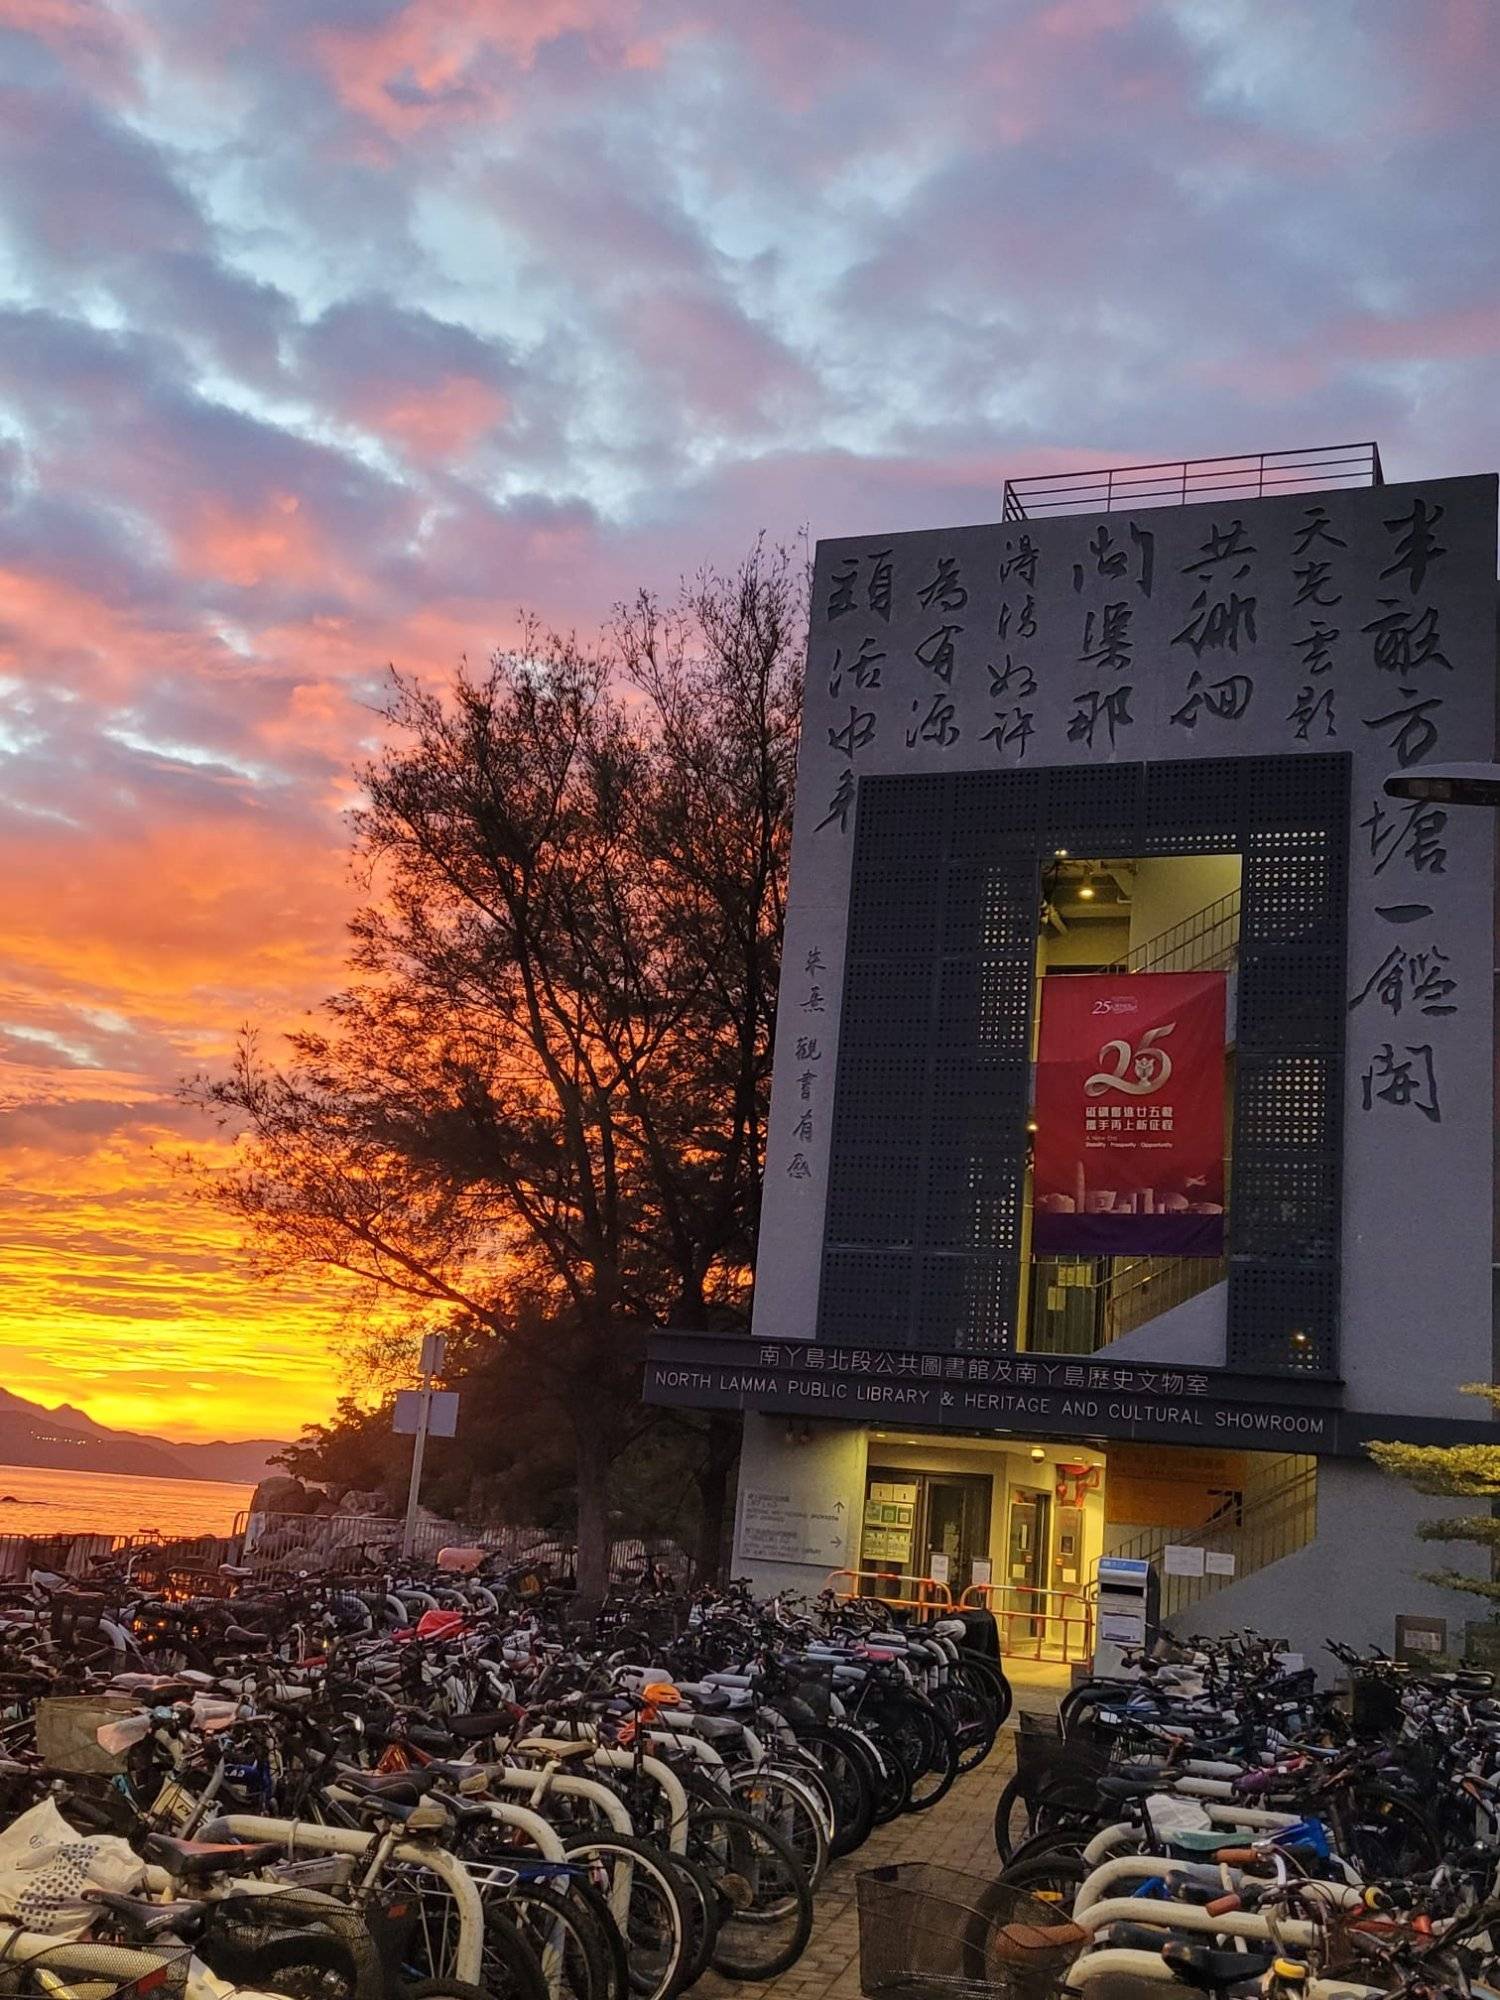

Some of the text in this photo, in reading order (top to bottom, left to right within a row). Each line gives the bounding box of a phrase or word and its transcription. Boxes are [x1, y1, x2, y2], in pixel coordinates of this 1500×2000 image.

[979, 534, 1040, 758] 得清如許
[1066, 522, 1154, 752] 問渠那
[1169, 519, 1257, 729] 共徘徊
[1287, 507, 1348, 742] 天光雲影
[1083, 1020, 1176, 1097] 25
[1092, 999, 1111, 1015] 25
[655, 1371, 1324, 1433] NORTH LAMMA PUBLIC LIBRARY & HERITAGE AND CULTURAL SHOWROOM
